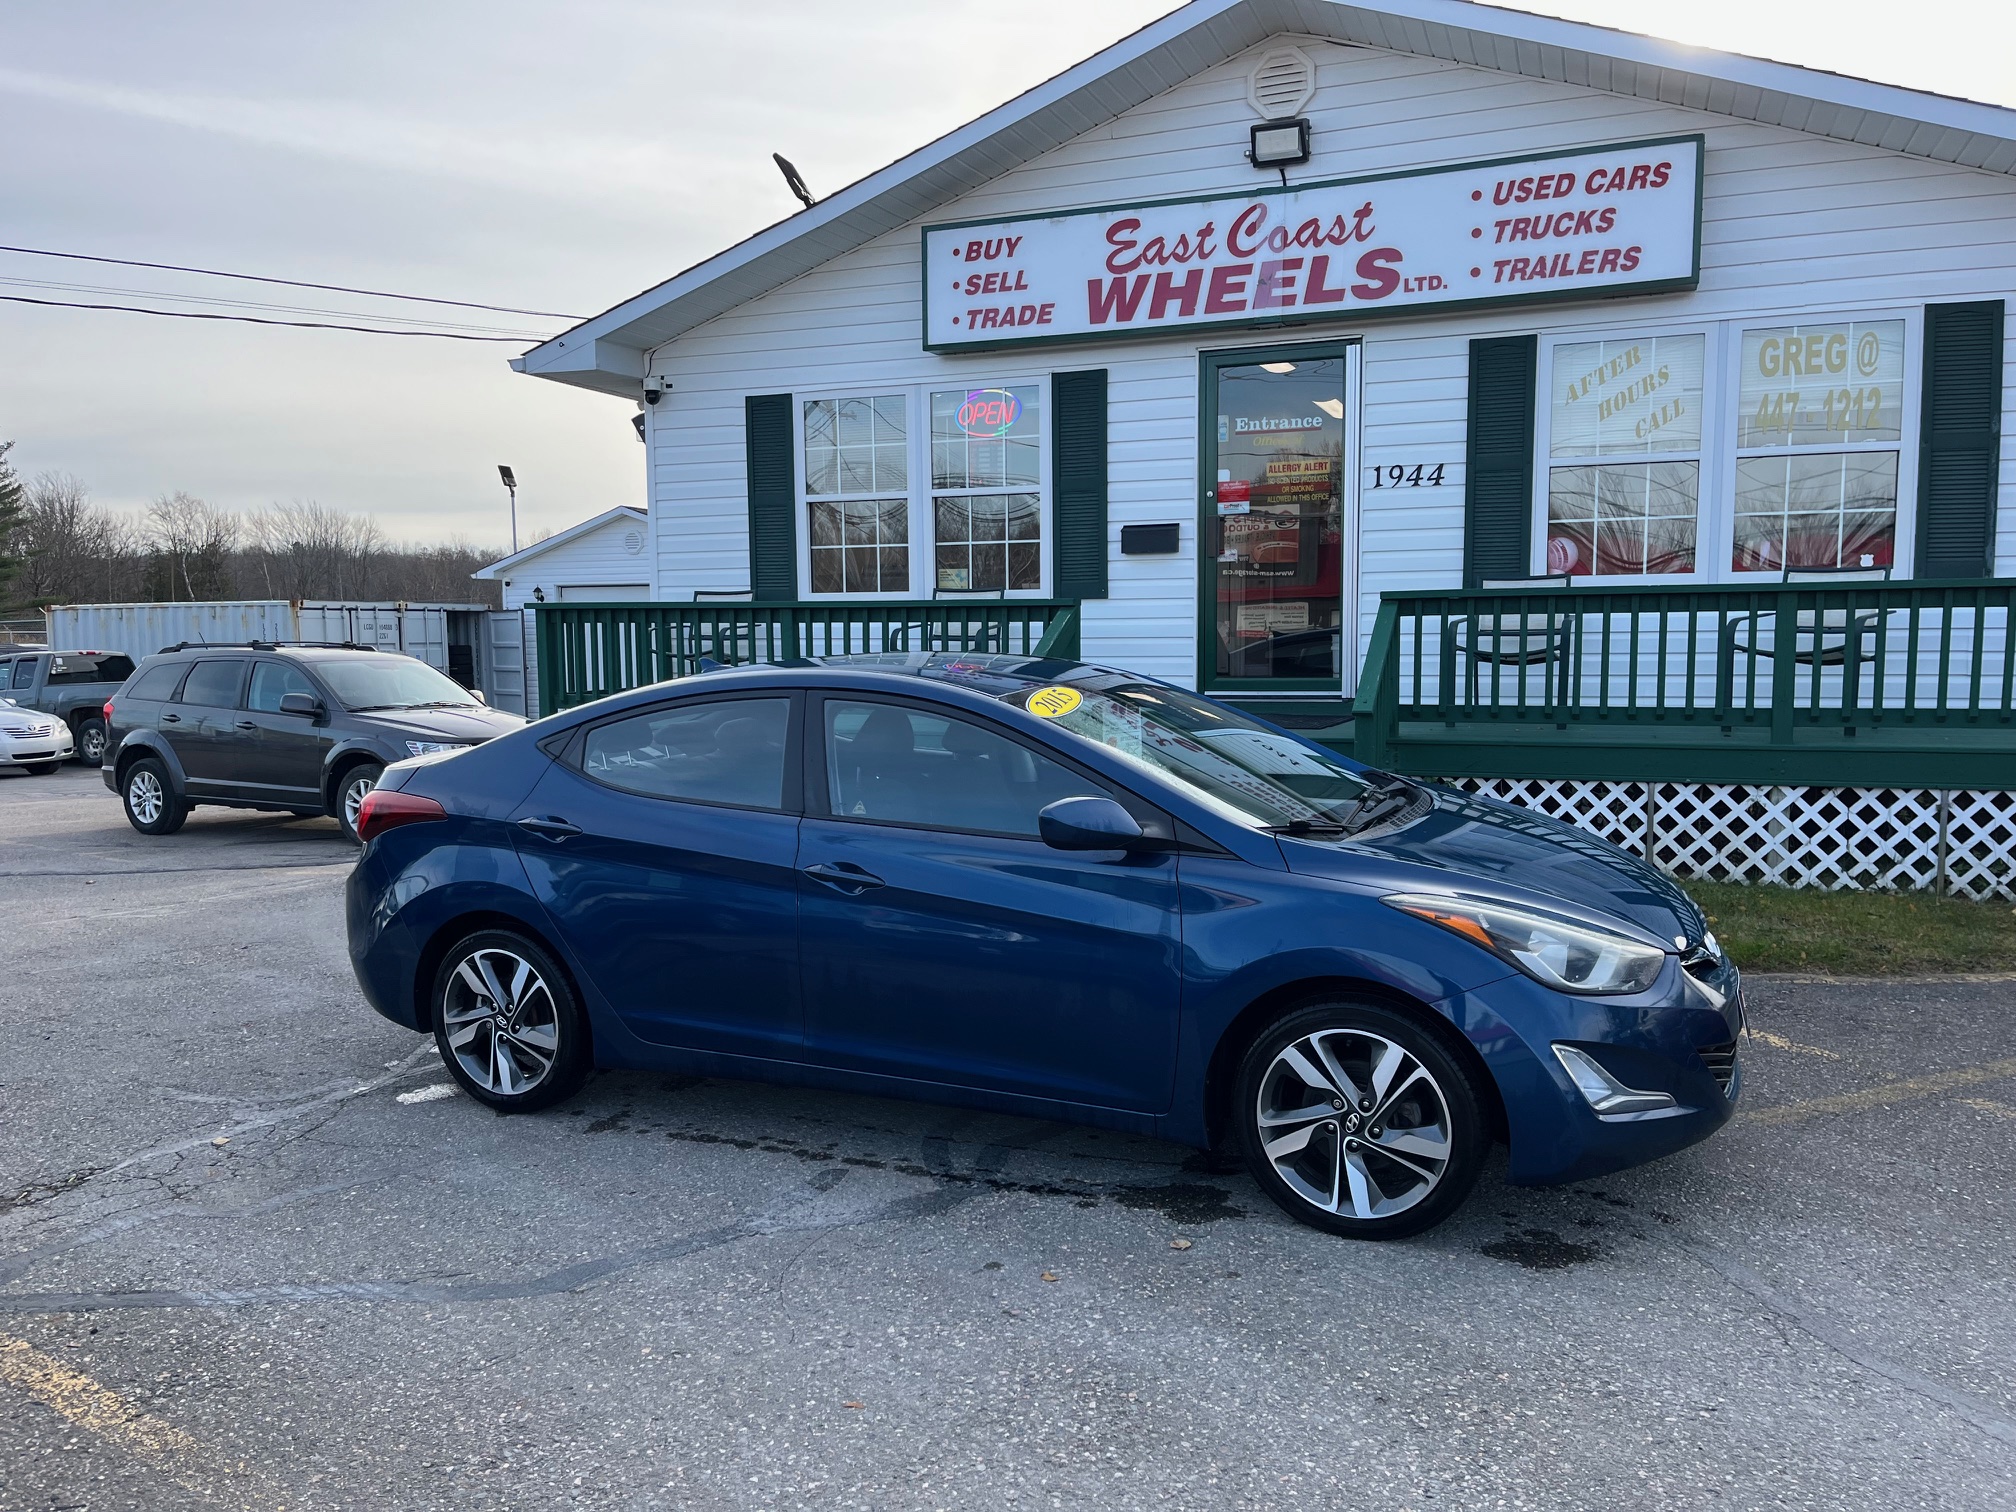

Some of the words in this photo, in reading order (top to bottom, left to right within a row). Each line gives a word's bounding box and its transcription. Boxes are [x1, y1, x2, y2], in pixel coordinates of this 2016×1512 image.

[1493, 173, 1576, 206] USED
[1585, 162, 1672, 195] CARS
[1105, 218, 1217, 275] East
[1226, 201, 1376, 258] Coast
[1494, 207, 1617, 244] TRUCKS
[964, 235, 1023, 262] BUY
[1493, 246, 1642, 283] TRAILERS
[964, 270, 1029, 296] SELL
[1087, 247, 1404, 325] WHEELS
[1403, 275, 1448, 293] LTD.
[966, 303, 1055, 330] TRADE
[1758, 333, 1847, 378] GREG
[1856, 331, 1880, 377] @
[1565, 345, 1642, 407] AFTER
[1598, 364, 1670, 422] HOURS
[958, 400, 1015, 426] OPEN
[1235, 416, 1323, 431] Entrance
[1635, 397, 1685, 439] CALL
[1755, 391, 1800, 435] 447
[1823, 387, 1882, 431] 1212
[1268, 463, 1302, 474] ALLERGY
[1304, 461, 1329, 472] ALERT
[1301, 474, 1329, 483] PRODUCTS
[1373, 463, 1445, 489] 1944
[1267, 494, 1292, 503] ALLOWED
[1299, 493, 1311, 501] THIS
[1311, 492, 1330, 501] OFFICE
[1290, 484, 1315, 493] SMOKING
[1035, 688, 1074, 715] 2015
